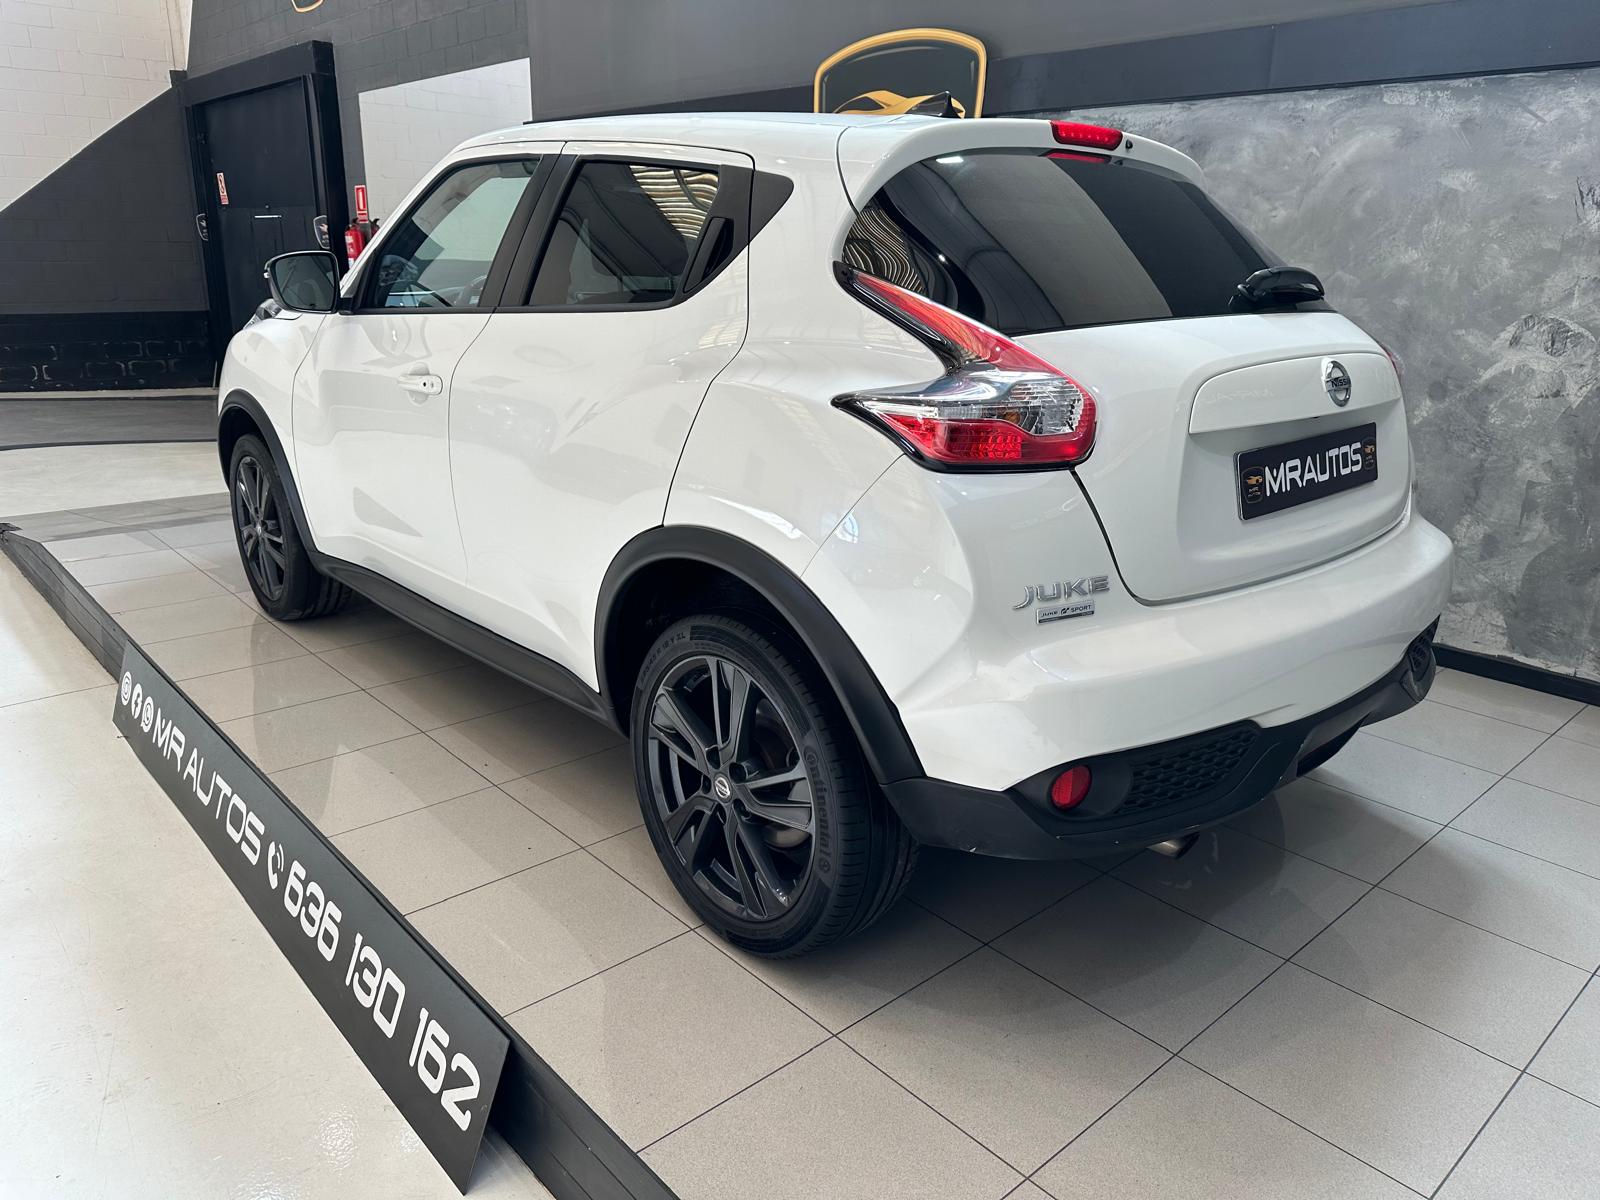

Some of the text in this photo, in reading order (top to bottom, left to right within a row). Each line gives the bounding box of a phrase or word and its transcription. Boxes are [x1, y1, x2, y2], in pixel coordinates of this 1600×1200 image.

[1012, 575, 1110, 611] JUKE
[1070, 604, 1091, 614] SPORT
[152, 707, 481, 1132] MR AUTOS 636 130 162
